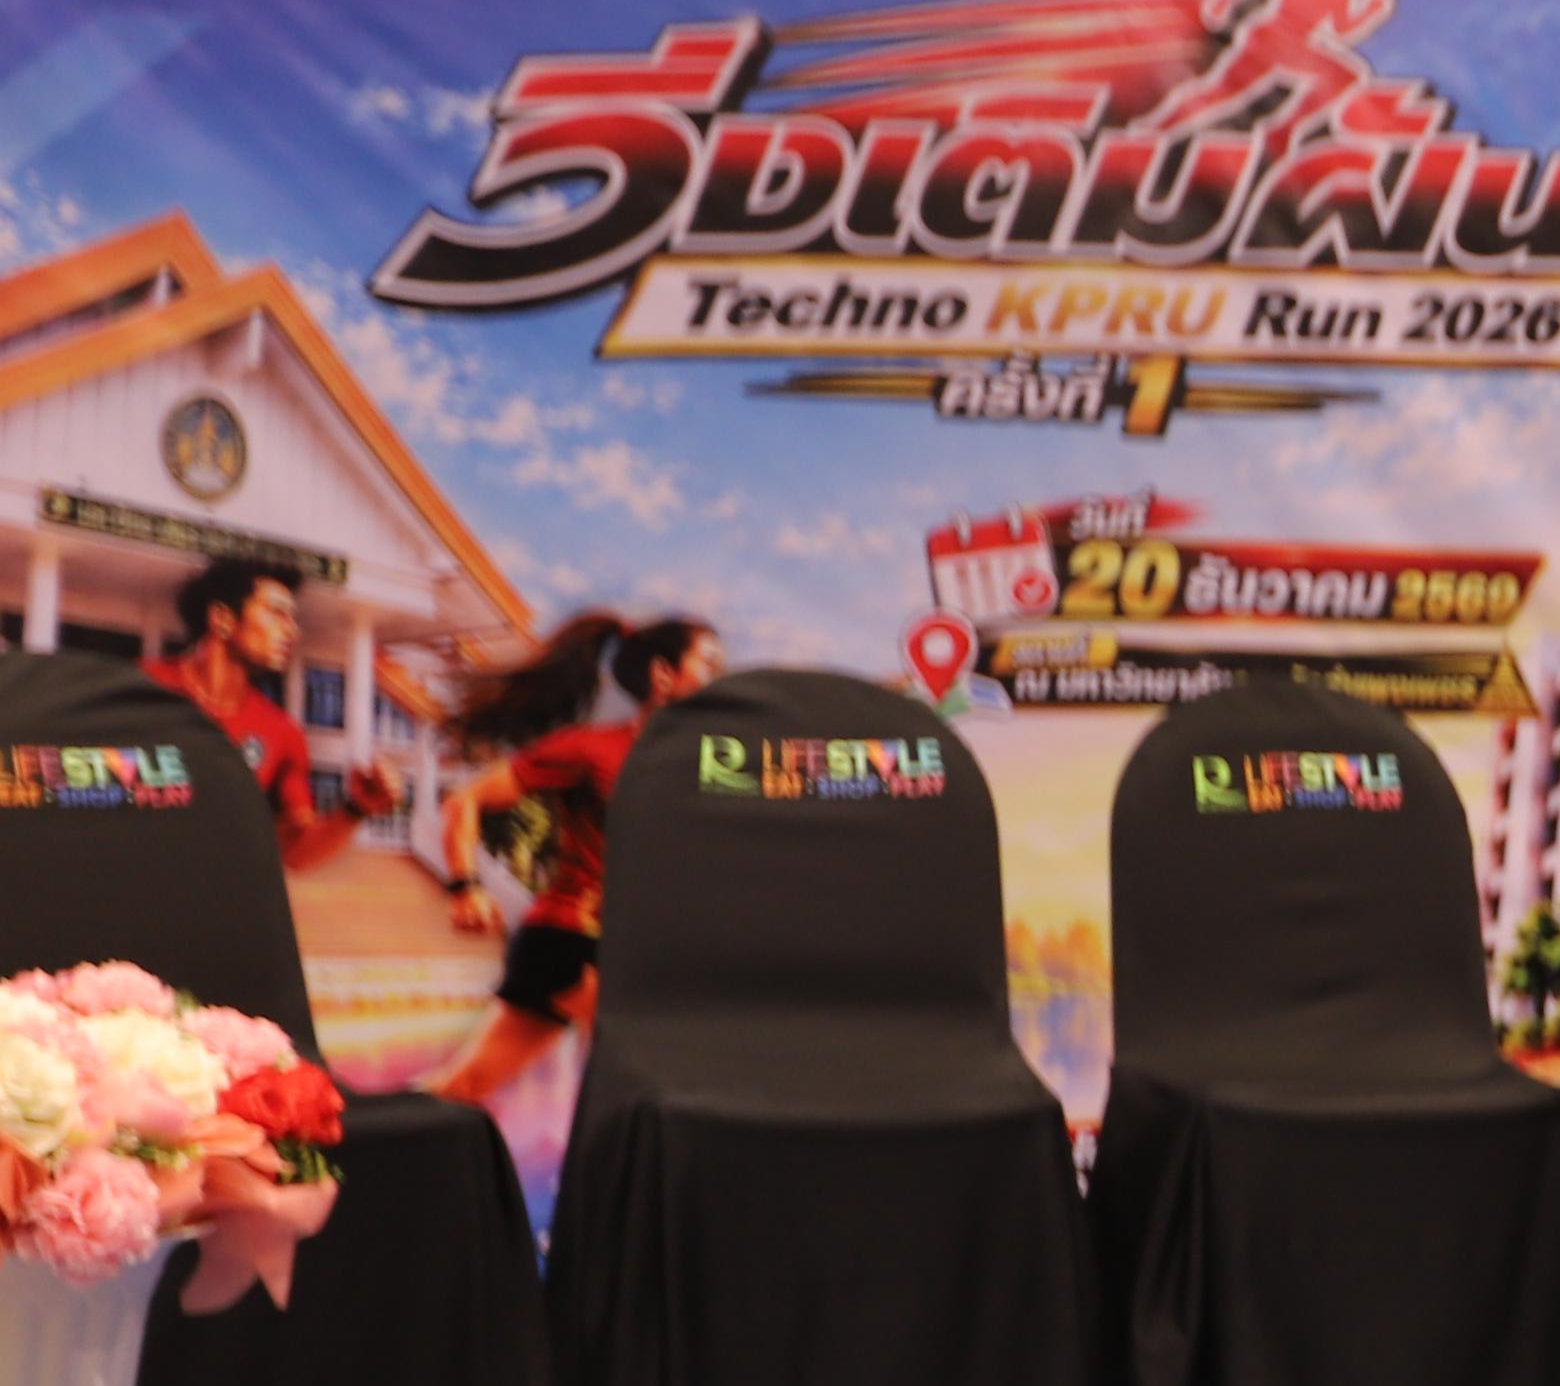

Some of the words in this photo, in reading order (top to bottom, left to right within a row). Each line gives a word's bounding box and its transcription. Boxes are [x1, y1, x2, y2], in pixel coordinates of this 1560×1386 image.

[684, 275, 969, 336] Techno
[985, 281, 1227, 340] KPRU
[1243, 291, 1384, 345] Run
[1122, 355, 1186, 437] 1
[1060, 539, 1181, 620] 20
[762, 736, 945, 782] LIFESTYLE
[1244, 751, 1402, 793] LIFESTYLE
